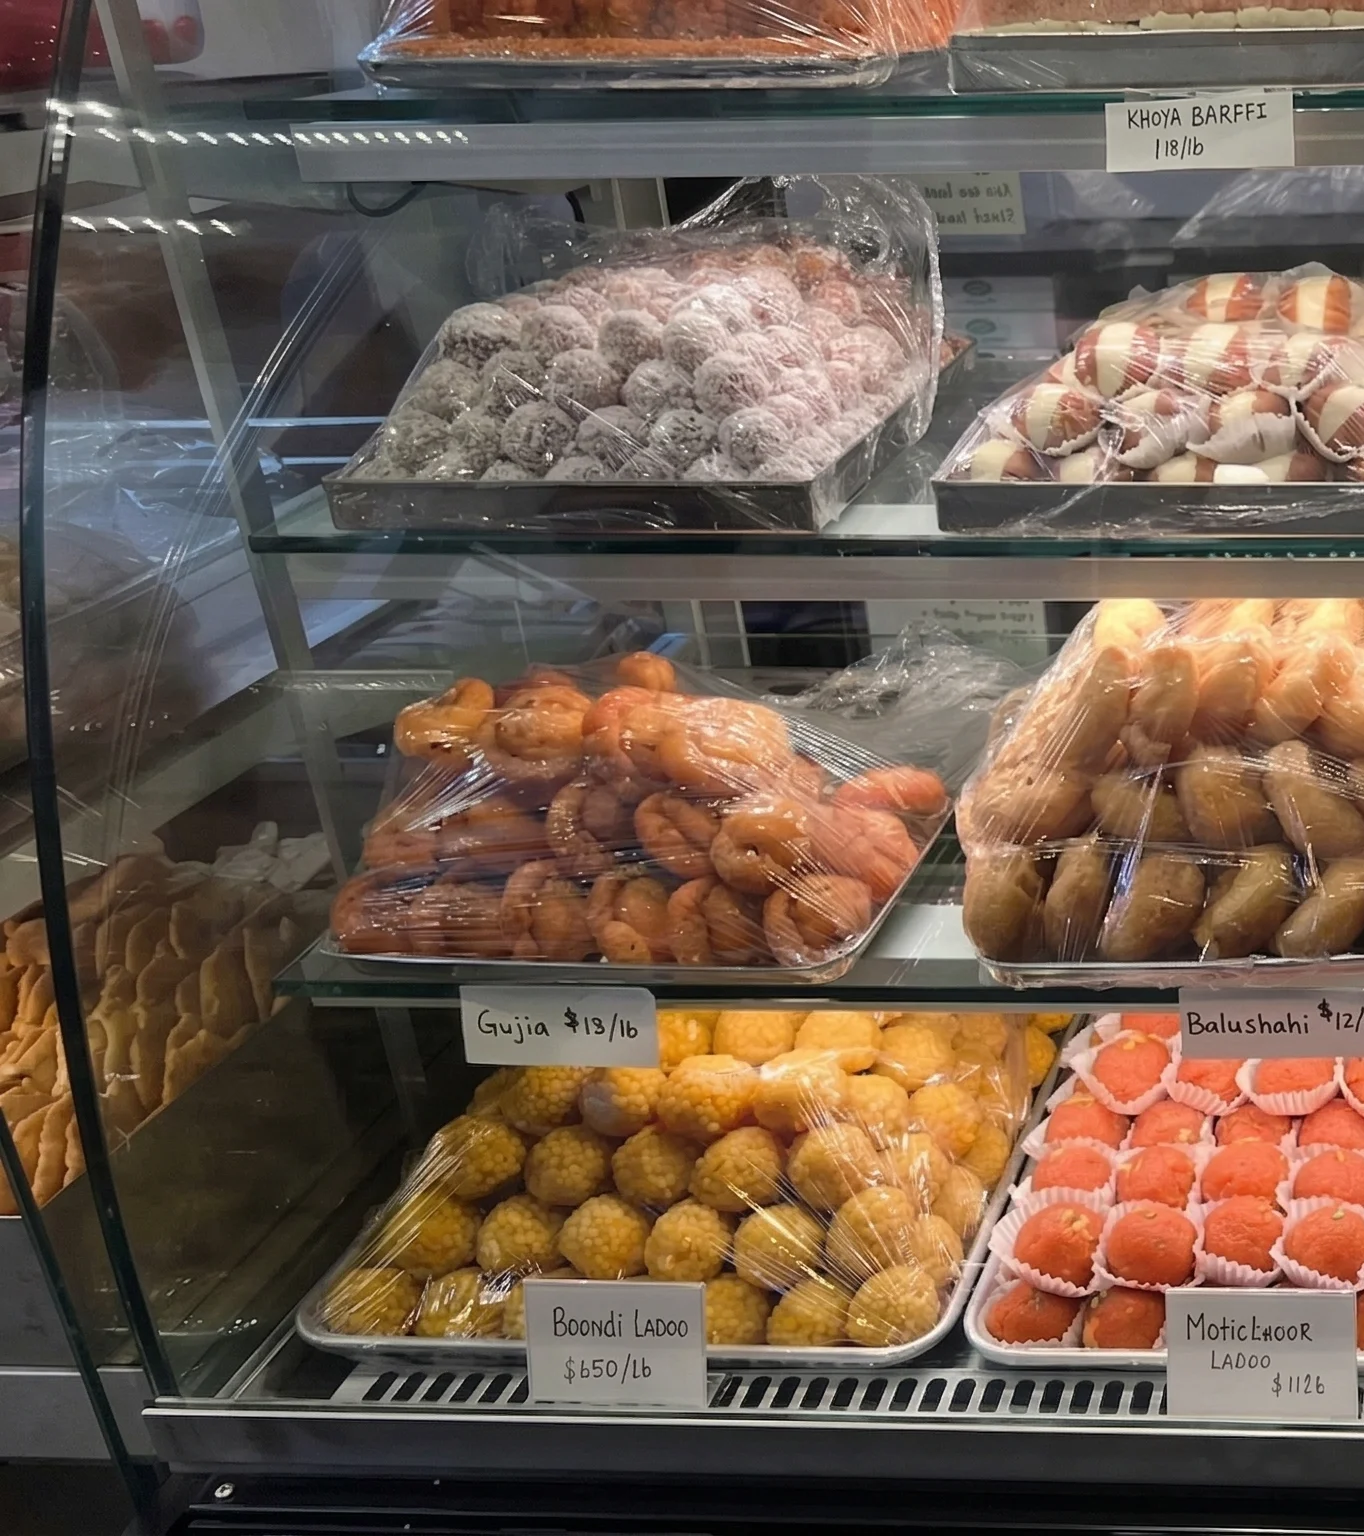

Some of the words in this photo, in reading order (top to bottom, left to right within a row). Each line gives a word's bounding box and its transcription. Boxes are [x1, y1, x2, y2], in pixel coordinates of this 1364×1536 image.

[1127, 107, 1182, 130] KHOYA
[1191, 102, 1268, 127] BARFFI
[477, 1009, 550, 1044] Gujia
[1186, 1011, 1310, 1036] Balushahi
[1211, 1350, 1271, 1370] LADOO
